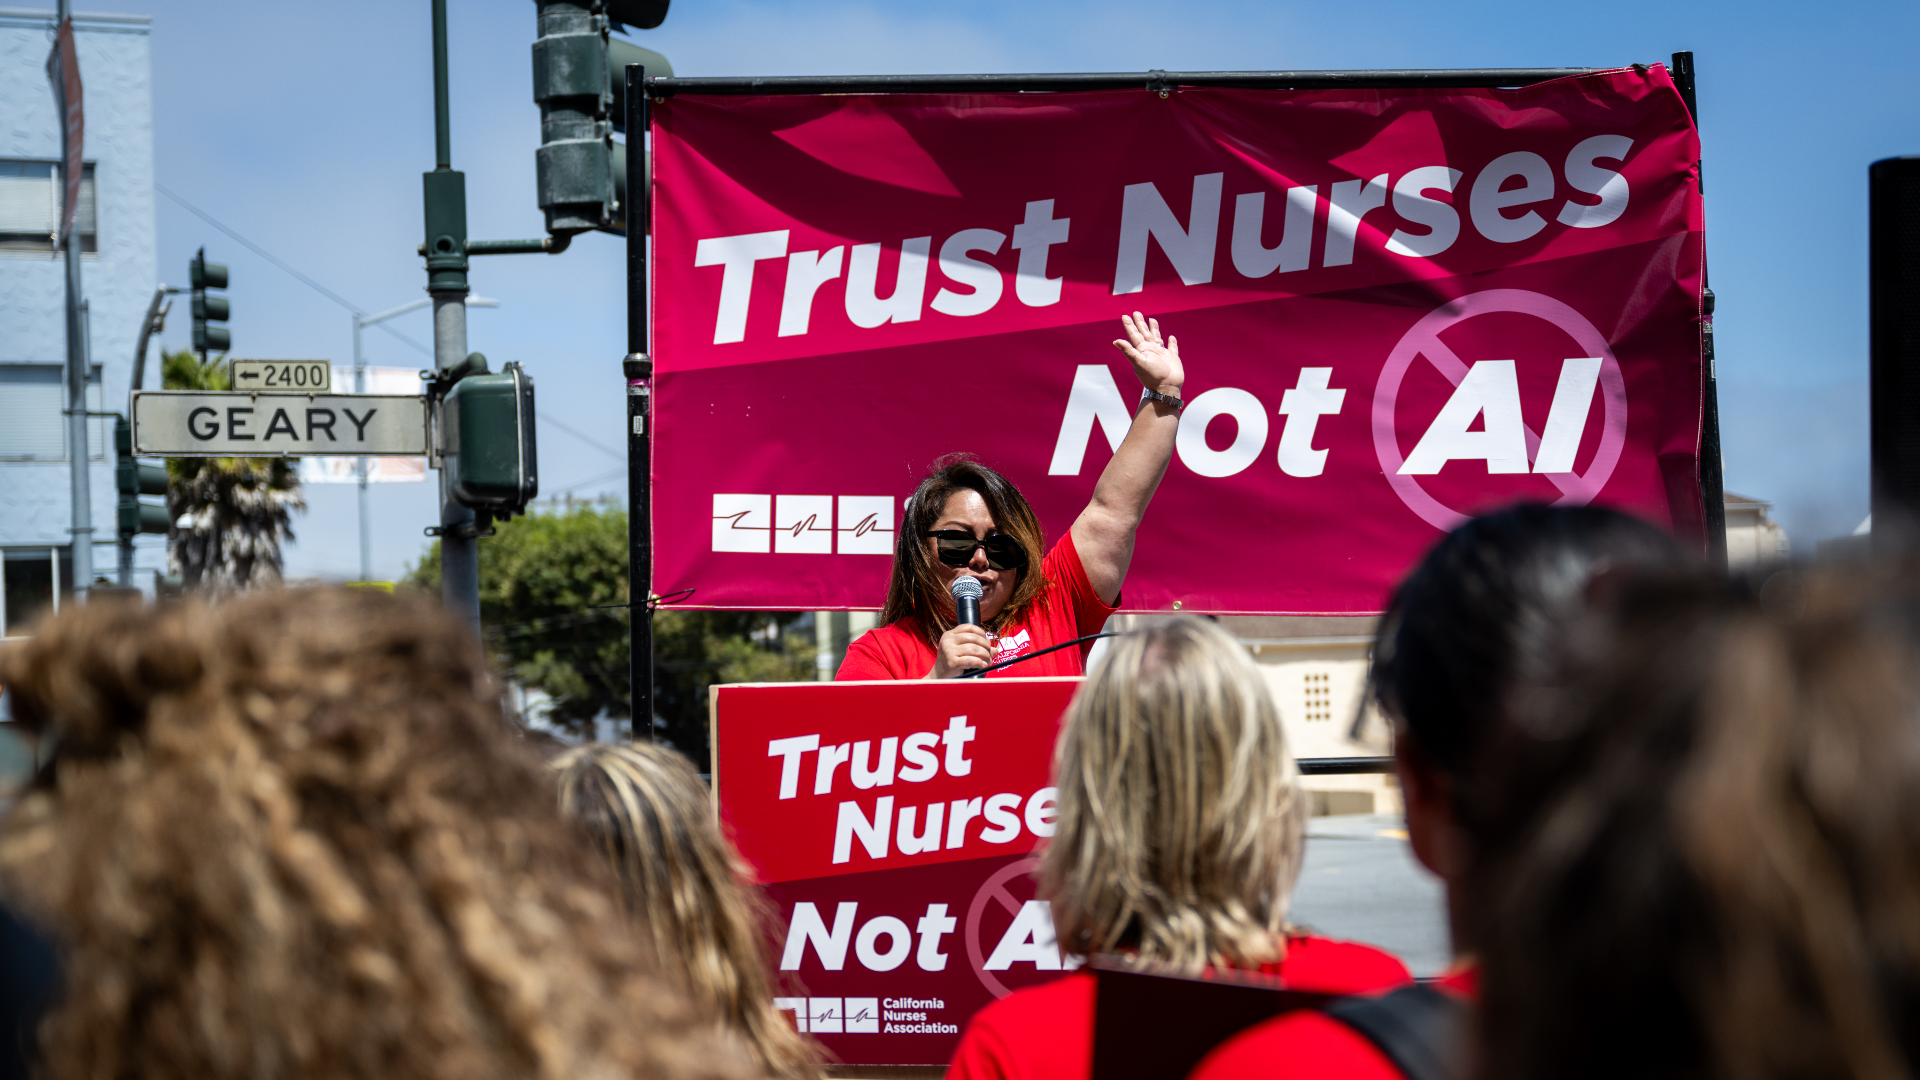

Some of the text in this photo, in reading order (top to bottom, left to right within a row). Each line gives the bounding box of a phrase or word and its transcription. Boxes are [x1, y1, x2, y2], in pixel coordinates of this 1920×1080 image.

[695, 134, 1635, 346] Trust Nurses
[264, 364, 324, 387] 2400
[187, 406, 378, 442] GEARY
[1048, 357, 1604, 478] Not AI
[768, 715, 977, 801] Trust
[832, 786, 1060, 865] Nurse
[780, 899, 1082, 972] Not A
[882, 997, 945, 1010] California
[883, 1010, 928, 1022] Nurses
[883, 1022, 958, 1035] Association
